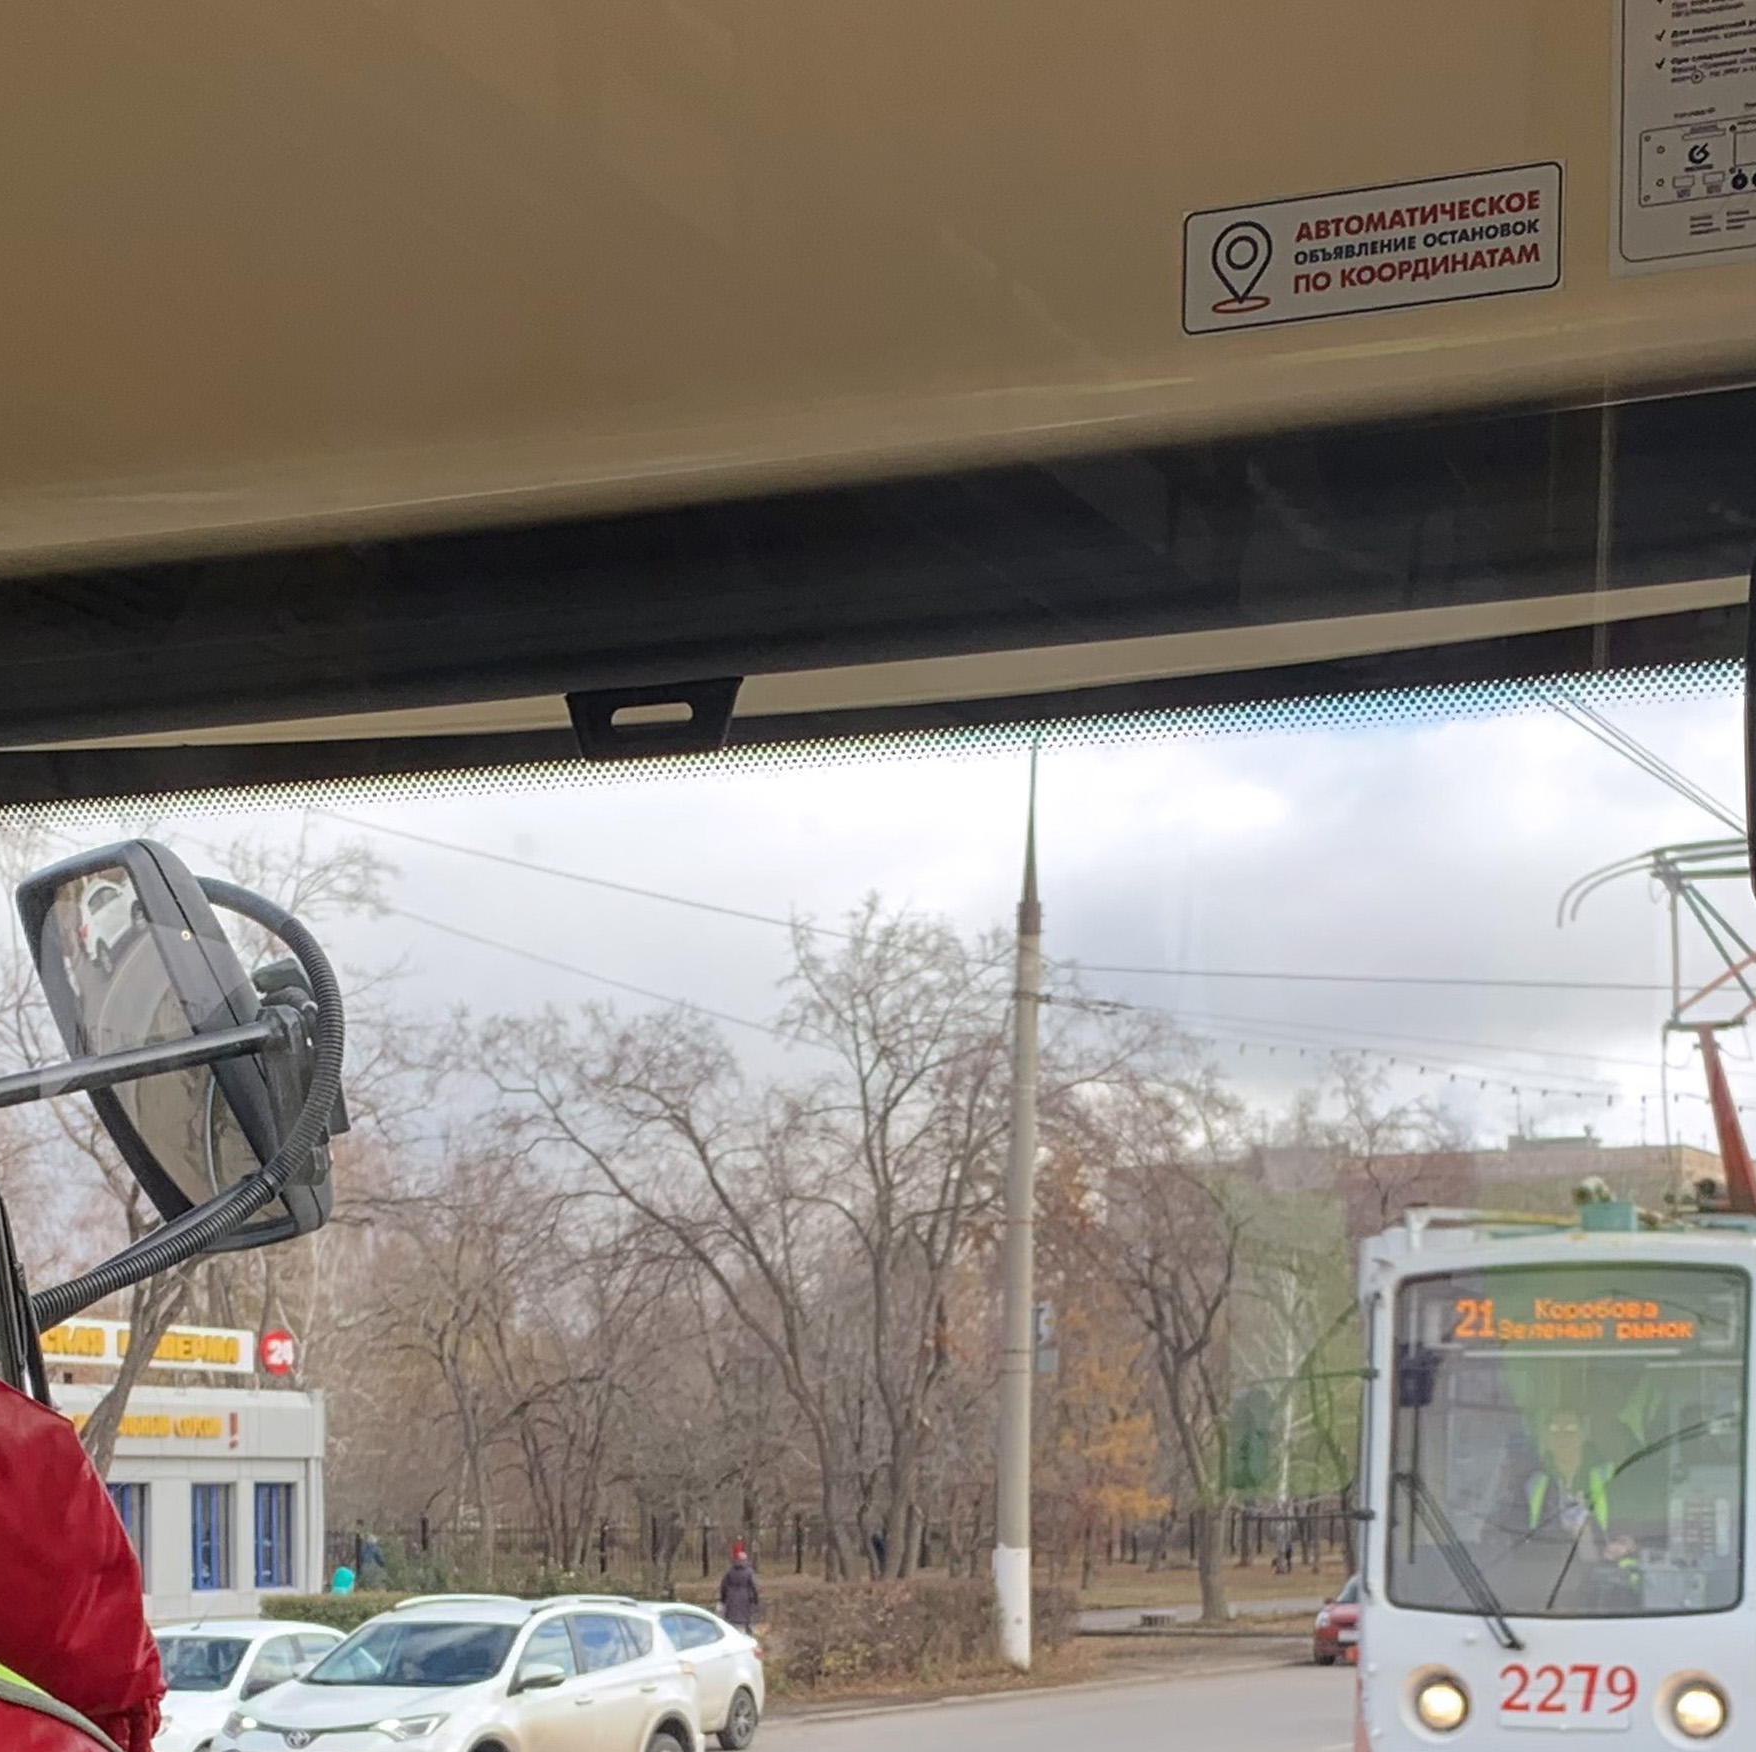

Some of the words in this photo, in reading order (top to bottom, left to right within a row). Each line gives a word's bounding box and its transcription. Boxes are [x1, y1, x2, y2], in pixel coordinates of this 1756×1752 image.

[1295, 190, 1541, 243] АВТОМАТИЧЕСКОЕ
[1294, 236, 1416, 265] ОБЪЯВЛЕНИЕ
[1423, 219, 1539, 247] ОСТАНОВОК
[1293, 271, 1331, 294] ПО
[1341, 243, 1540, 288] КООРДИНАТАМ
[1455, 1298, 1494, 1338] 21
[1534, 1298, 1660, 1319] Коробова
[1616, 1321, 1694, 1340] рынок
[266, 1339, 293, 1366] 24
[1500, 1663, 1638, 1714] 2279
